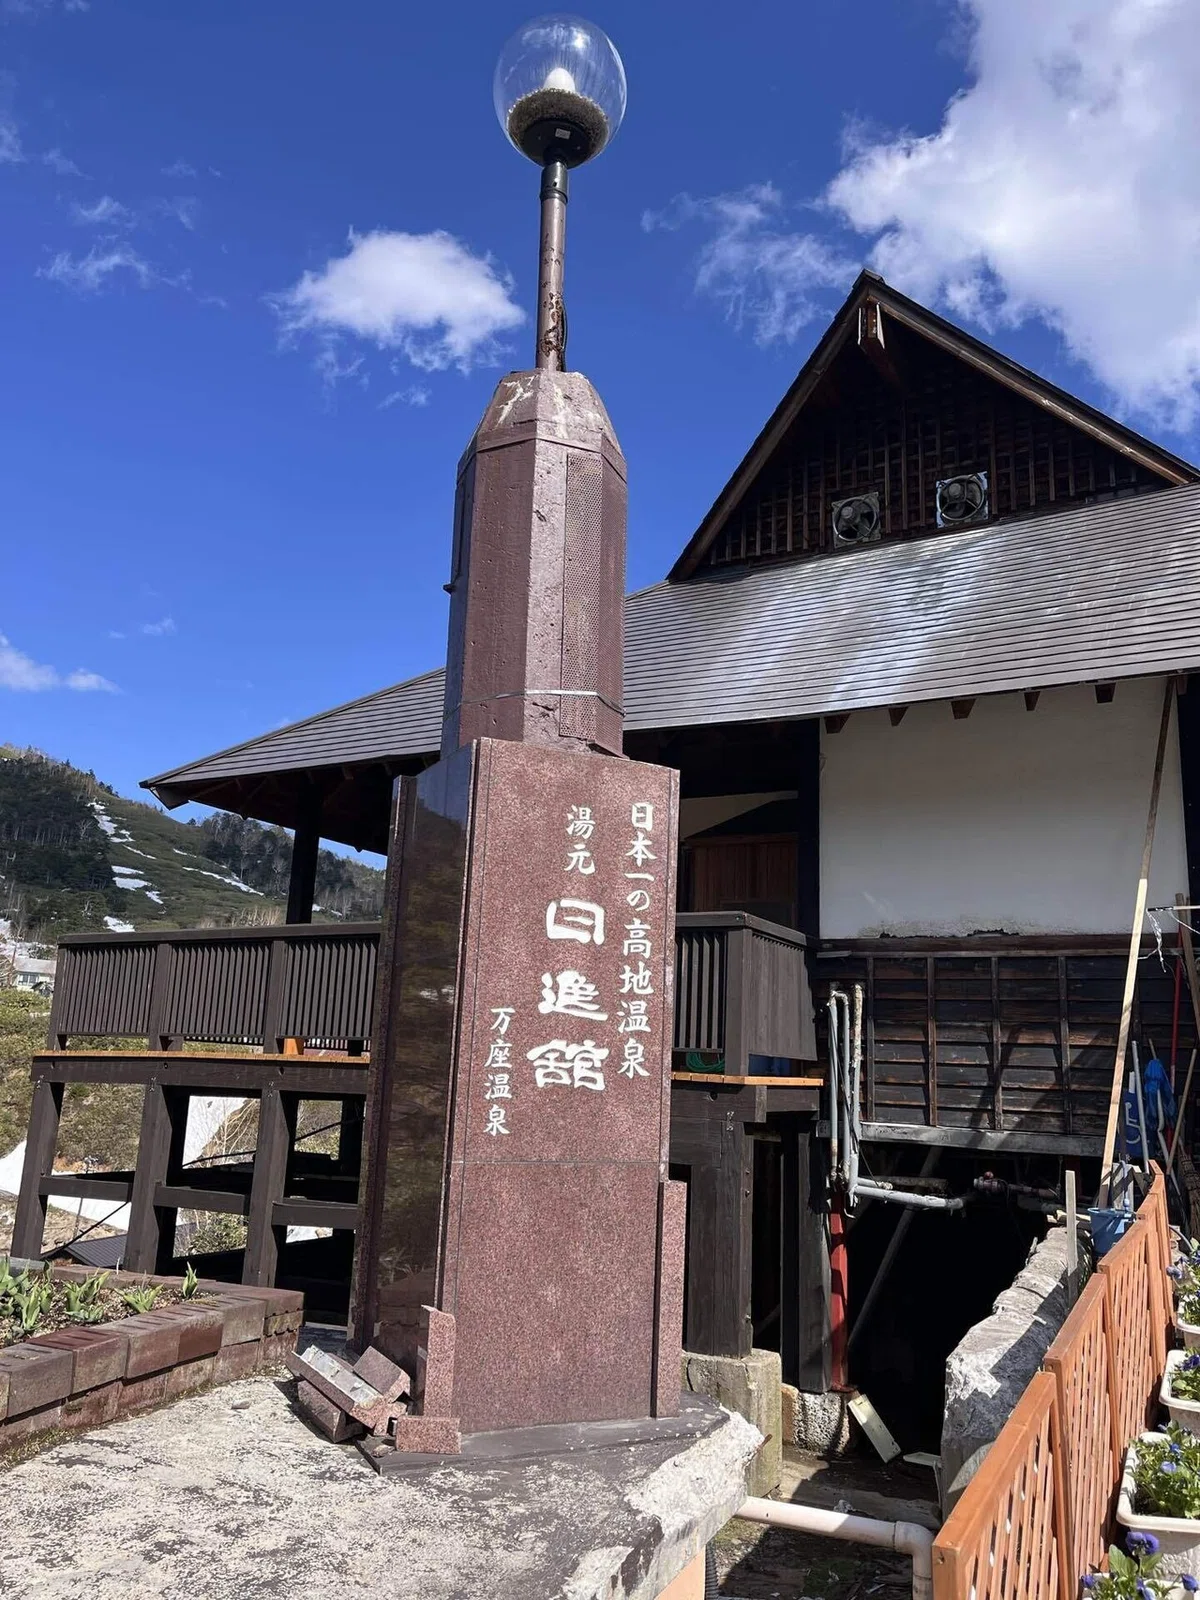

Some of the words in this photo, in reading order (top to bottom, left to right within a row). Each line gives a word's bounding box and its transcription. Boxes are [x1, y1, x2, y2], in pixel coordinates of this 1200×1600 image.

[564, 804, 597, 876] 湯元
[616, 802, 658, 1080] 日本一の高地温泉
[483, 1006, 517, 1136] 万座温泉
